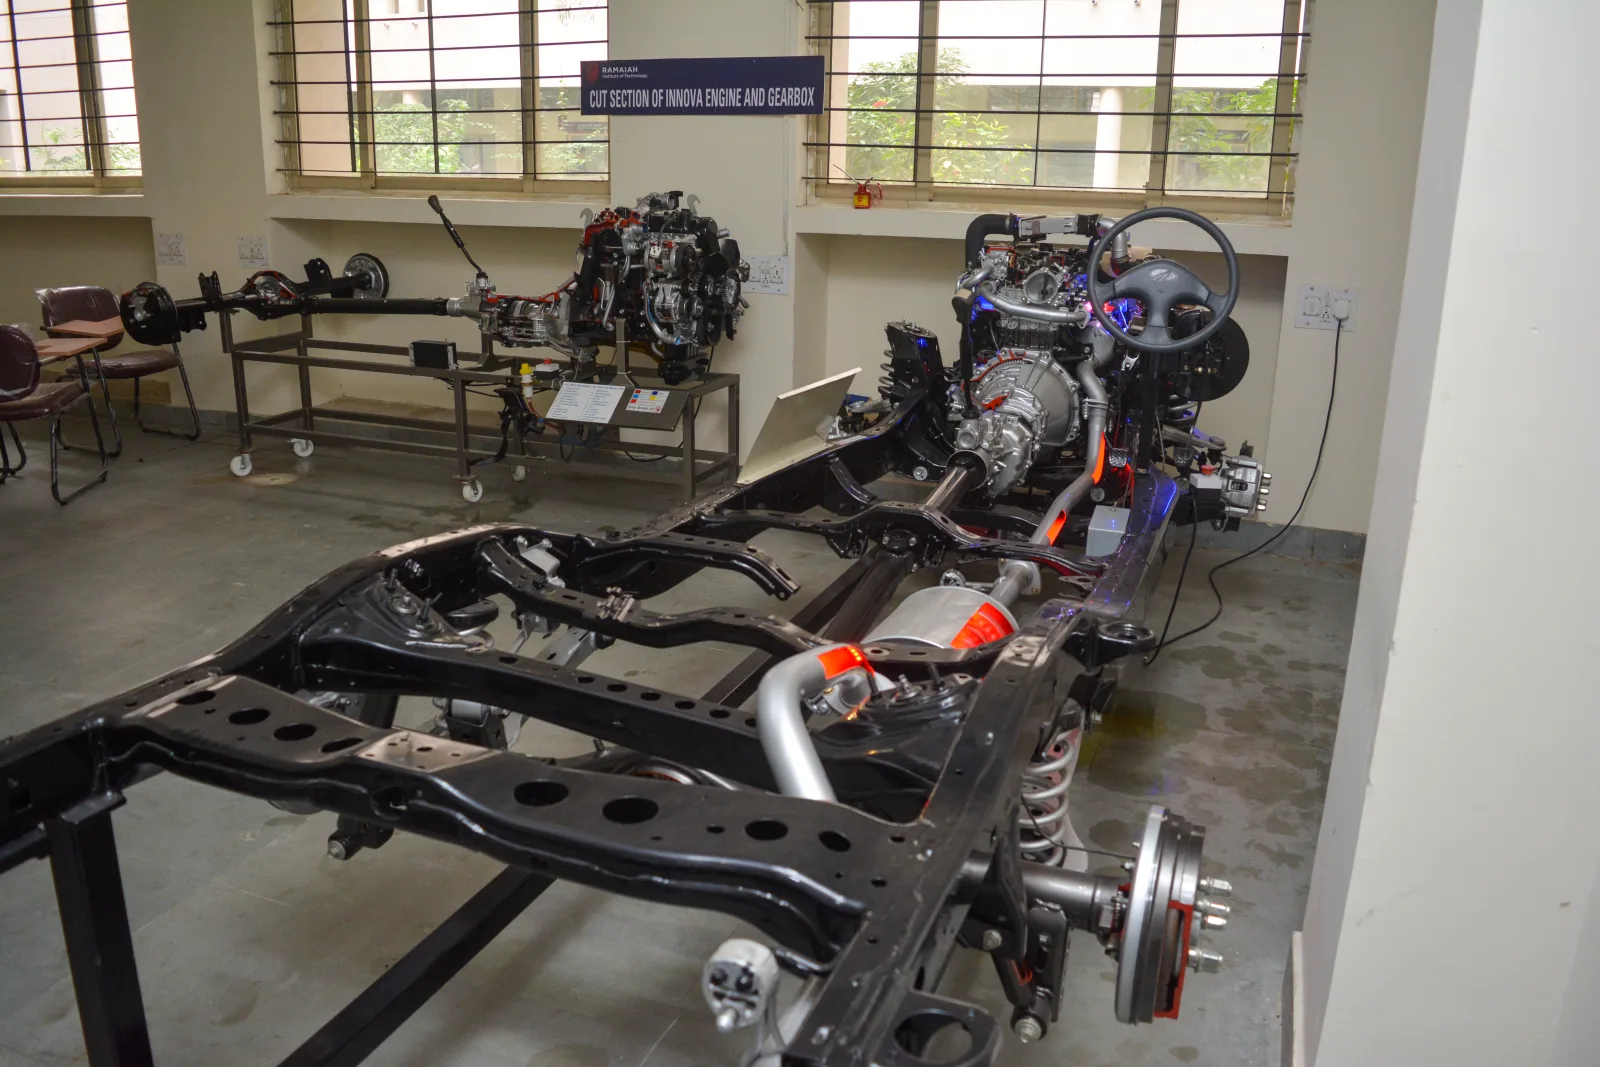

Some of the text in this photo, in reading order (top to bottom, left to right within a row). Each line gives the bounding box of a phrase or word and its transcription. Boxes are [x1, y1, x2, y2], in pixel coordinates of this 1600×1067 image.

[589, 87, 815, 108] CUT SECTION OF INNOVA ENGINE AND GEARBOX
